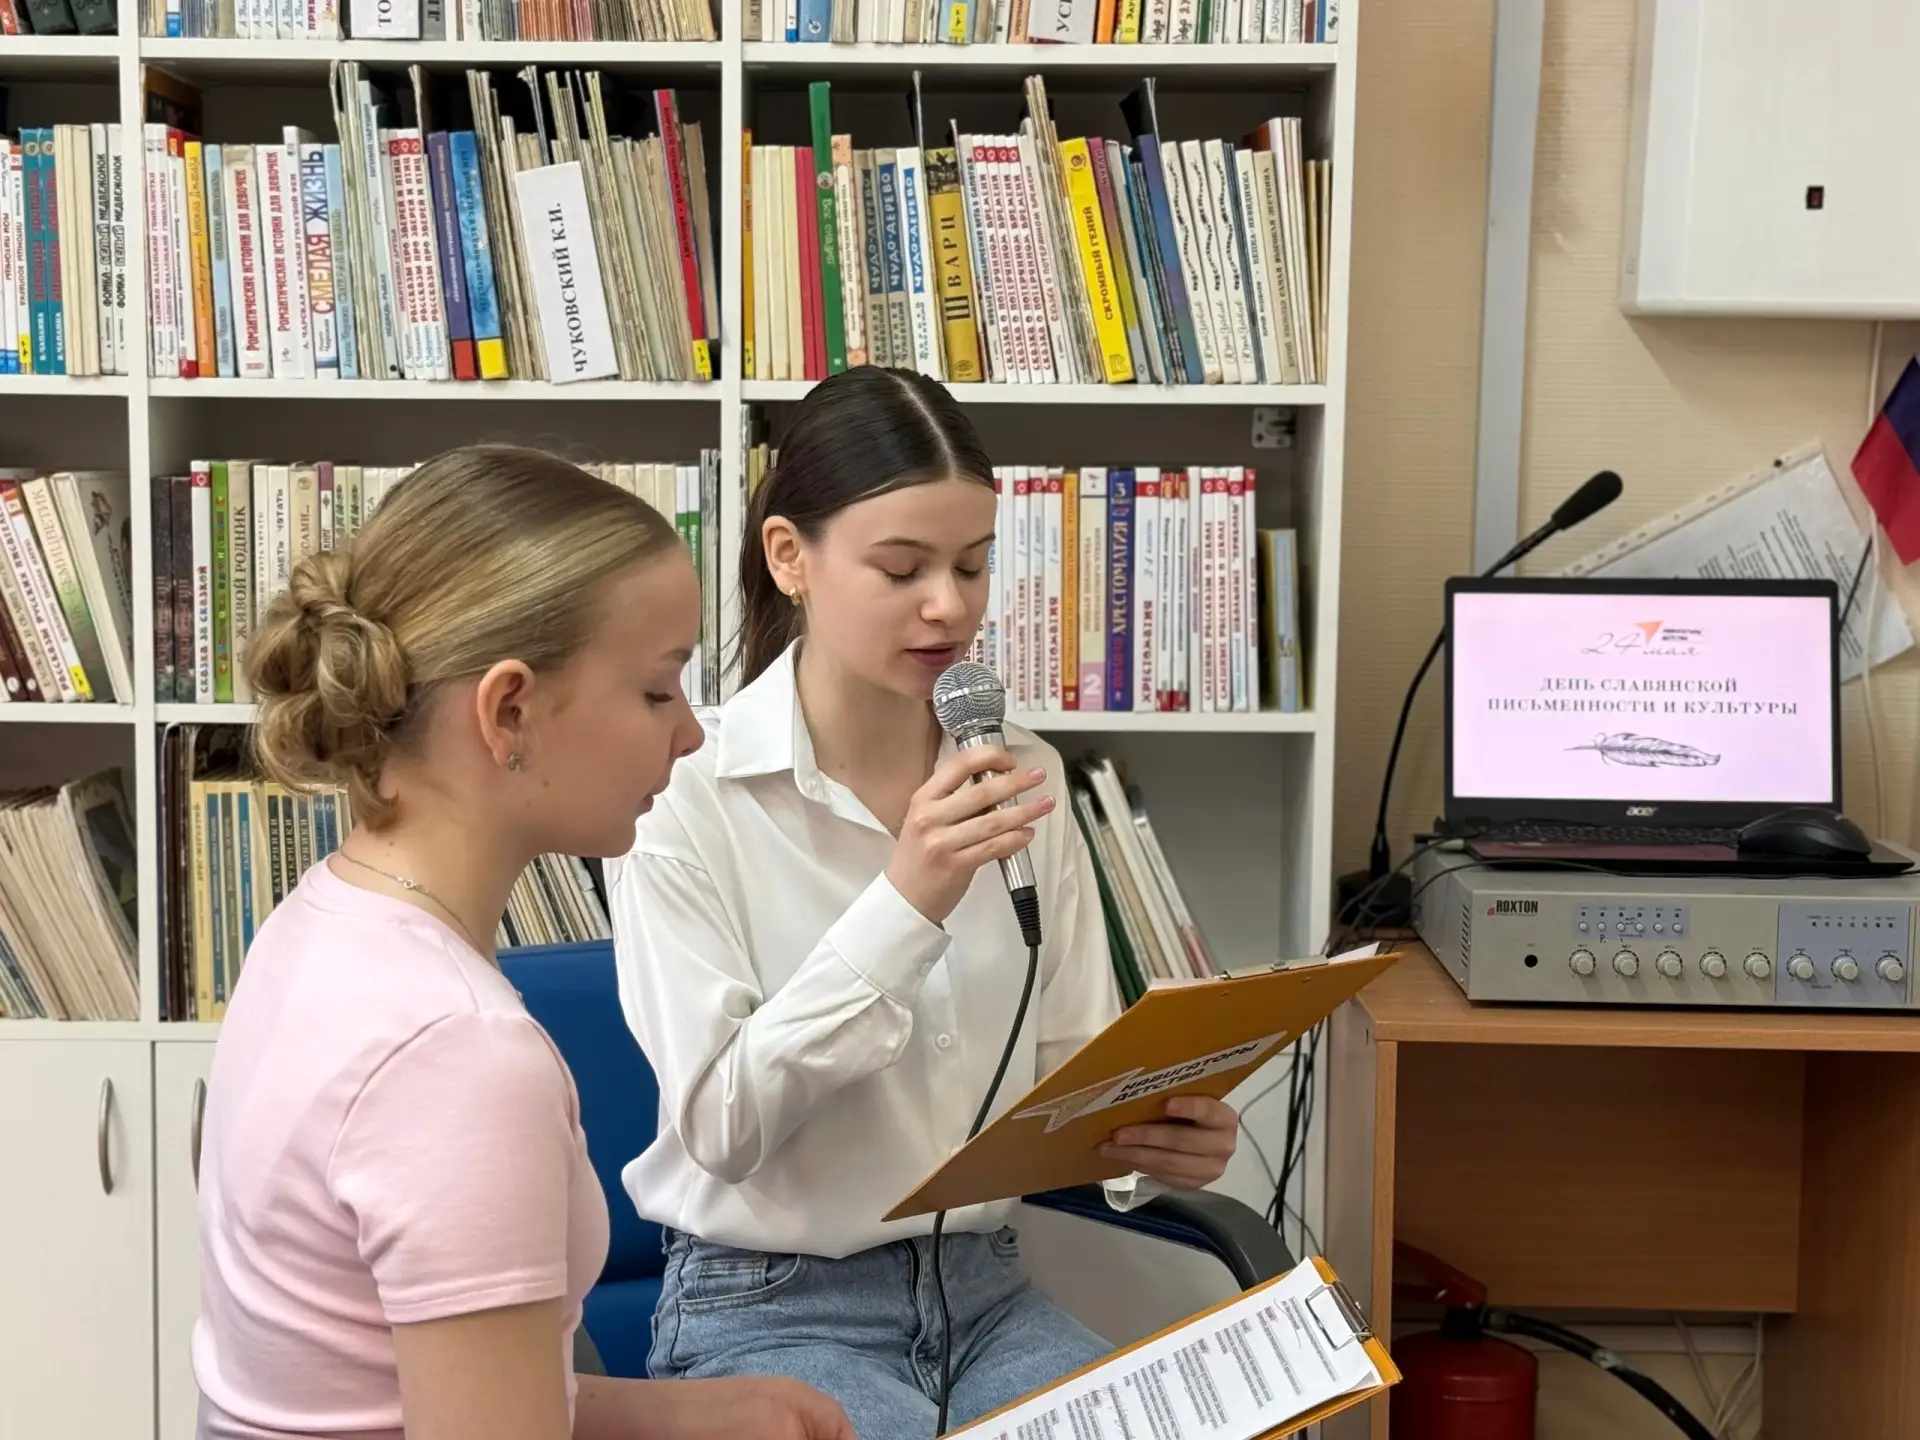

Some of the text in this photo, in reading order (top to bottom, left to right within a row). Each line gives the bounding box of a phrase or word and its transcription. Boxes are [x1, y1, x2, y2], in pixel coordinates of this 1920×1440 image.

[97, 154, 108, 220] МЕДВЕЖОНОК
[113, 155, 123, 222] МЕДВЕЖОНОК
[395, 189, 403, 197] И
[405, 187, 413, 195] И
[415, 186, 423, 194] И
[978, 174, 994, 228] ВРЕМЕНИ
[991, 174, 1006, 228] ВРЕМЕНИ
[1003, 174, 1018, 228] ВРЕМЕНИ
[1013, 174, 1029, 228] ВРЕМЕНИ
[302, 151, 335, 314] СМЕЛАЯ ЖИЗНЬ
[397, 199, 408, 239] ЗВЕРЕЙ
[406, 197, 417, 237] ЗВЕРЕЙ
[416, 196, 428, 236] ЗВЕРЕЙ
[863, 177, 880, 289] ЧУДО-ДЕРЕВО
[881, 172, 899, 287] ЧУДО-ДЕРЕВО
[904, 177, 923, 288] ЧУДО-ДЕРЕВО
[974, 208, 983, 228] КОТА
[402, 243, 412, 263] ПРО
[411, 241, 421, 262] ПРО
[421, 240, 431, 261] ПРО
[940, 214, 971, 321] ШВАРЦ
[1083, 205, 1114, 320] СКРОМНЫЙ ГЕНИЙ
[103, 272, 112, 306] ФОМКА
[117, 274, 126, 308] ФОМКА
[405, 267, 419, 323] РАССКАЗЫ
[414, 266, 428, 322] РАССКАЗЫ
[424, 265, 439, 322] РАССКАЗЫ
[547, 203, 589, 373] ЧУКОВСКИЙ К.И.
[1001, 326, 1015, 371] СКАЗКА
[1013, 326, 1027, 371] СКАЗКА
[1025, 326, 1039, 371] СКАЗКА
[1035, 326, 1049, 371] СКАЗКА
[233, 506, 248, 640] ЖИВОЙ РОДНИК
[1112, 521, 1128, 635] ХРЕСТОМАТИЯ
[198, 566, 208, 693] СКАЗКА ЗА СКАЗКОЙ
[1204, 577, 1212, 638] РАССКАЗЫ
[1218, 576, 1226, 637] РАССКАЗЫ
[1049, 596, 1058, 698] ХРЕСТОМАТИЯ
[1143, 600, 1152, 702] ХРЕСТОМАТИЯ
[1489, 699, 1797, 715] ПИСЬМЕННОСТИ И КУЛЬТУРЫ
[1541, 677, 1738, 694] ДЕНЬ СЛАВЯНСКОЙ
[1626, 806, 1657, 816] acer
[1496, 900, 1538, 913] ROXTON
[1111, 1069, 1206, 1104] ДЕТСТВА
